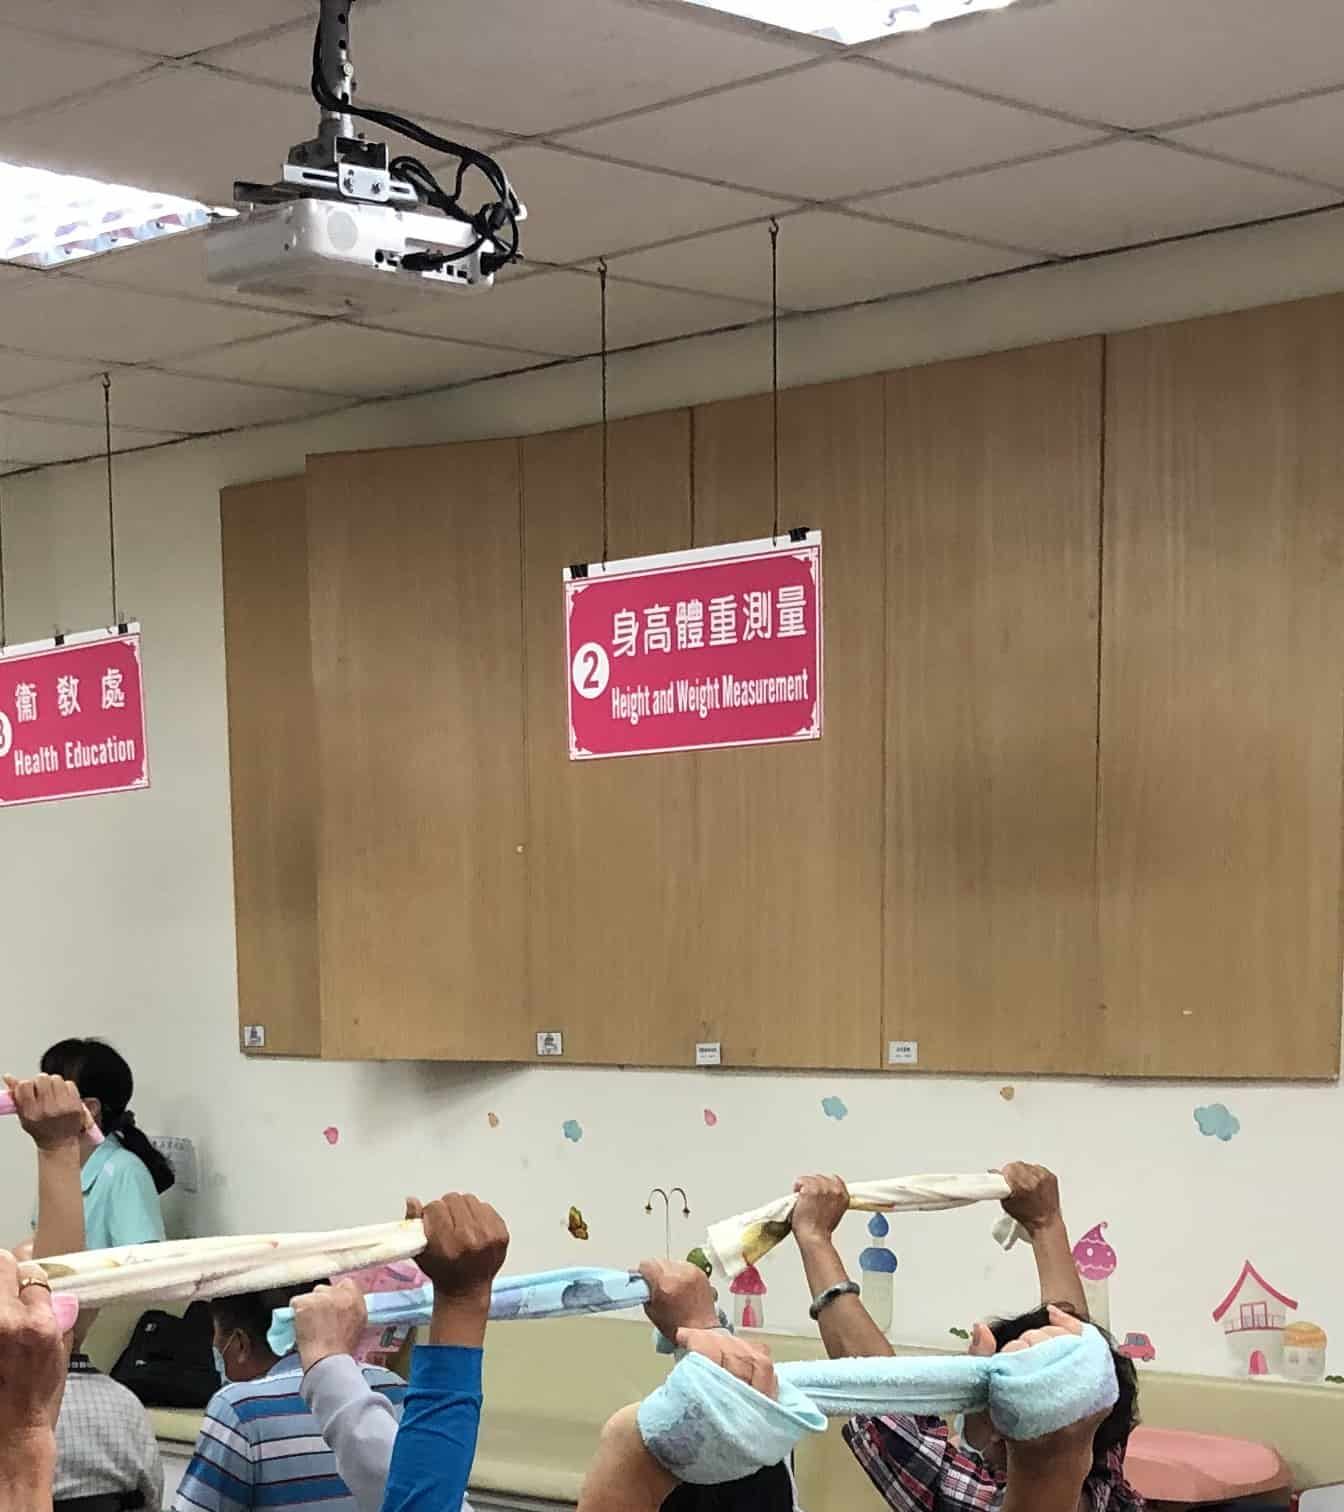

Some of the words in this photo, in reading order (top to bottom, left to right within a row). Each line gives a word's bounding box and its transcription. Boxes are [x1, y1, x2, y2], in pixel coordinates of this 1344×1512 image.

[611, 585, 807, 657] 身高體重測量
[611, 686, 650, 726] Height
[652, 682, 674, 715] and
[676, 675, 720, 718] Weight
[722, 668, 808, 708] Measurement
[14, 746, 59, 776] Health
[65, 735, 136, 769] Education
